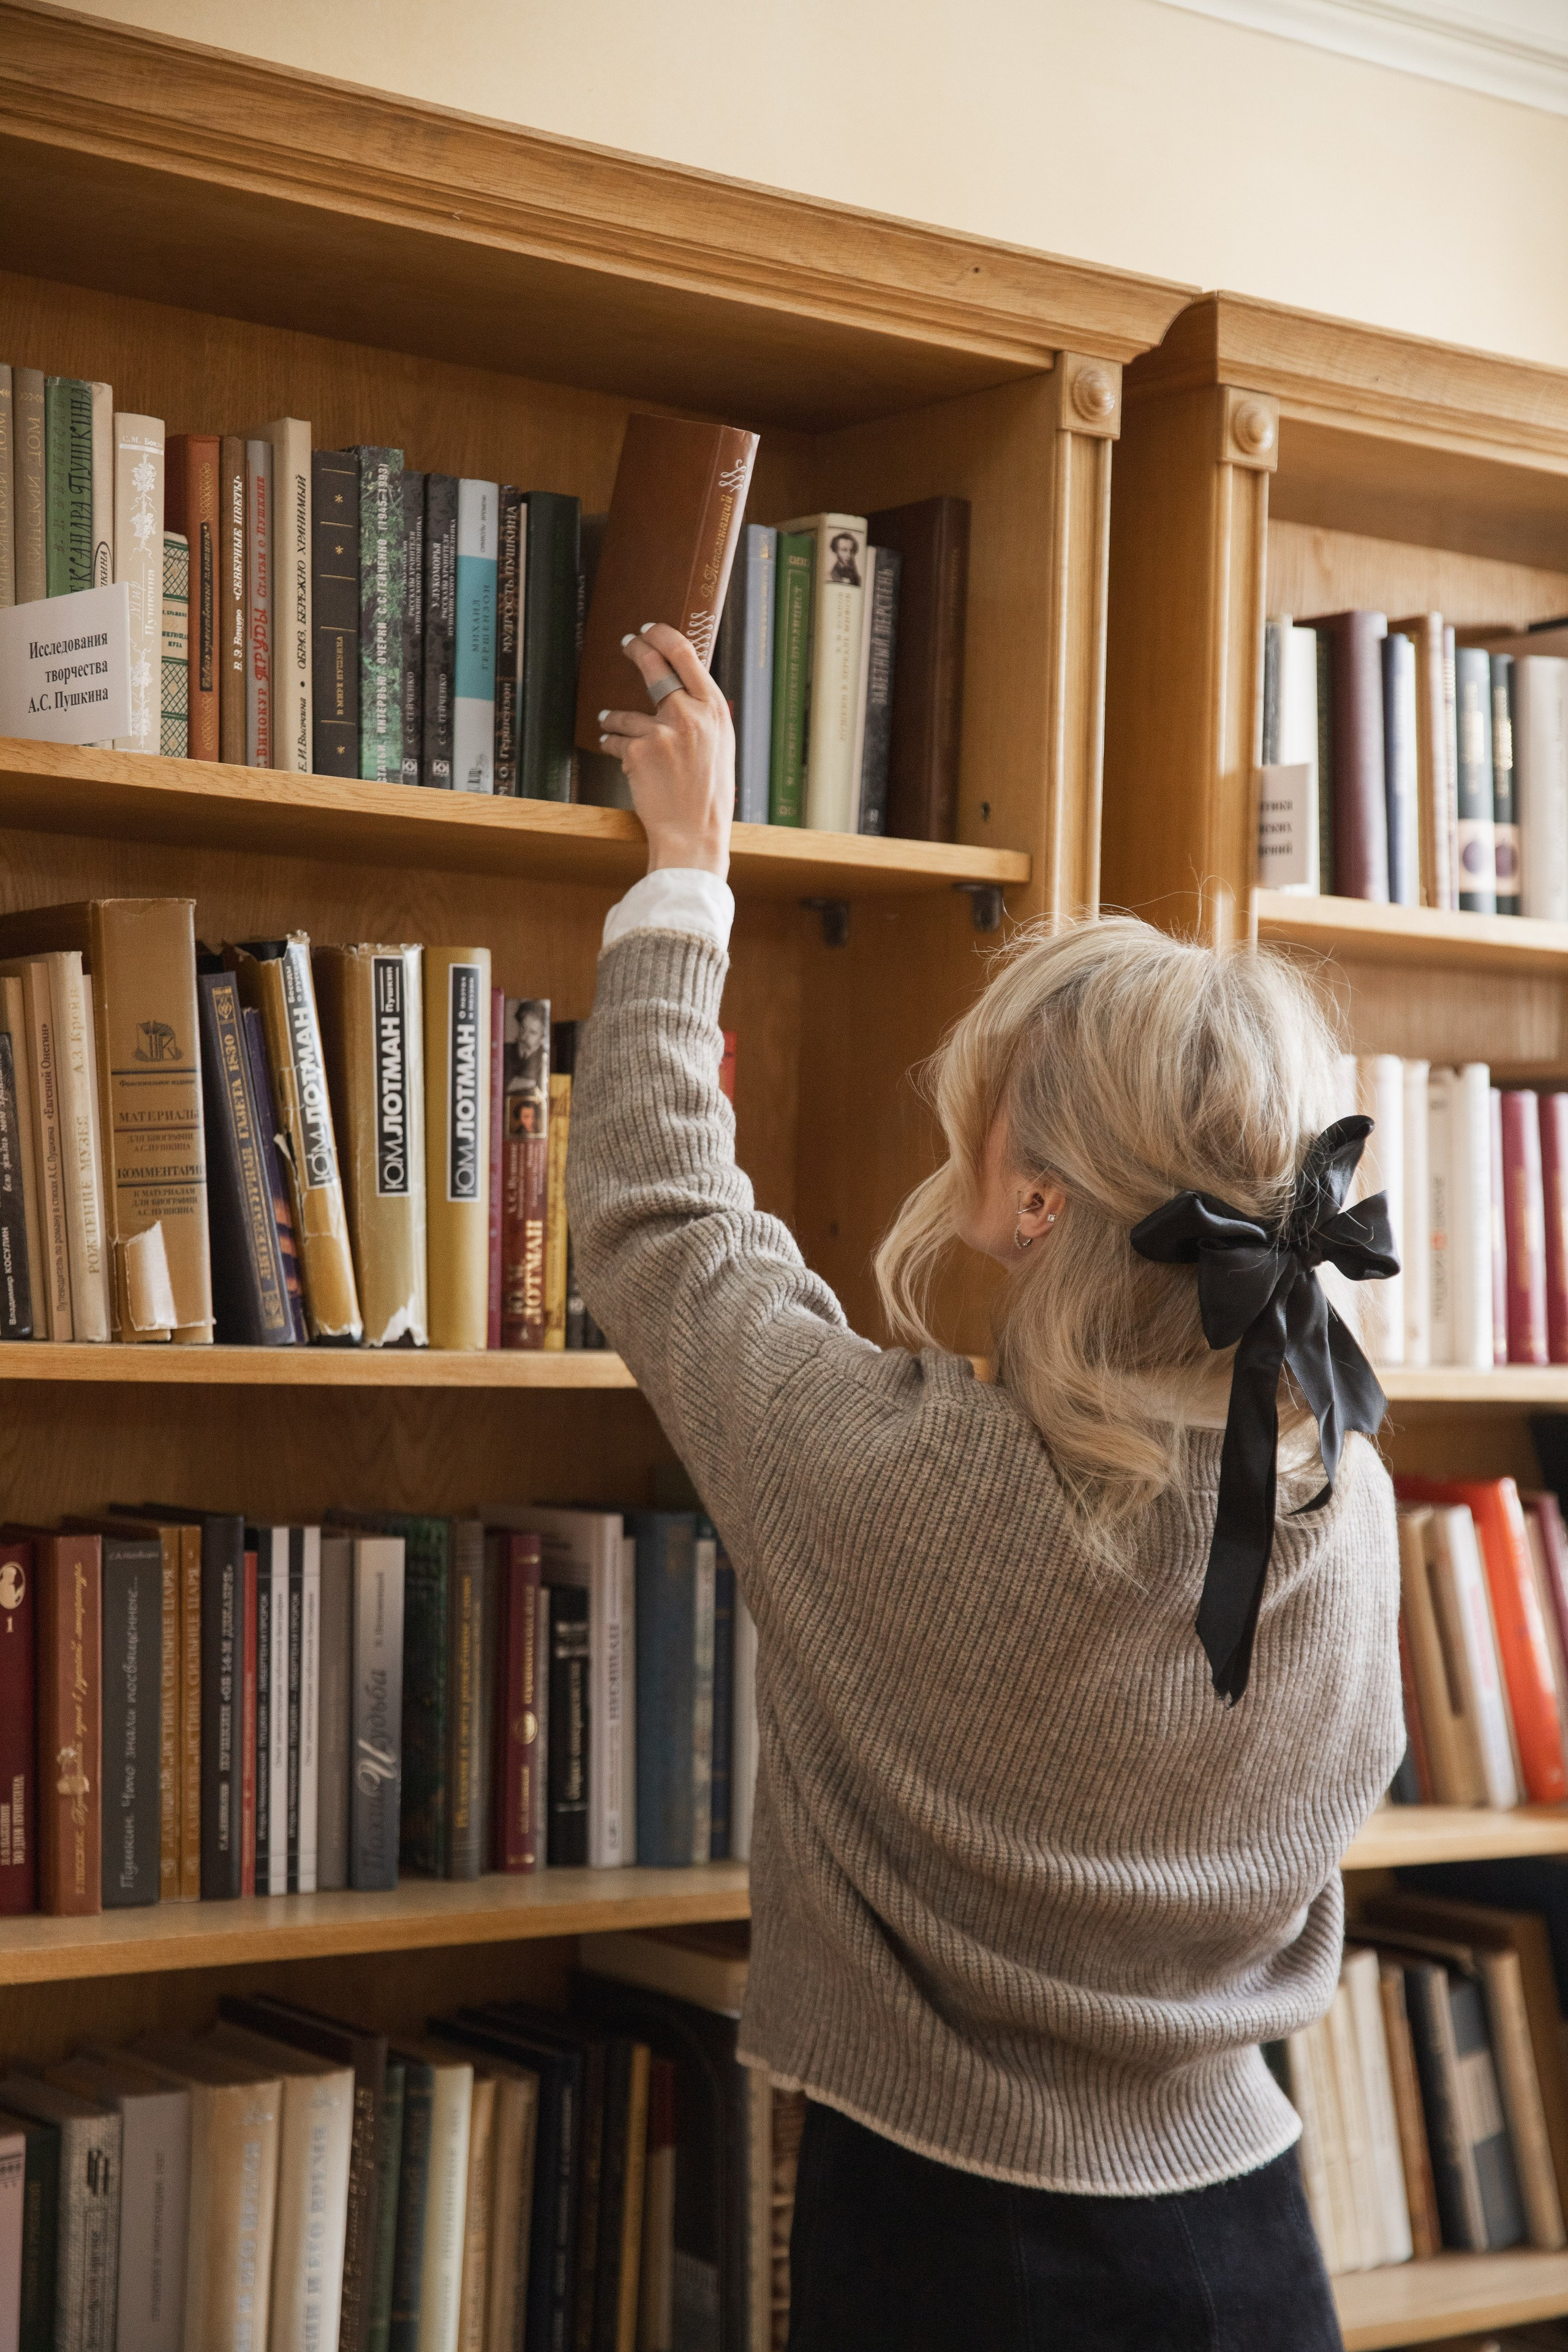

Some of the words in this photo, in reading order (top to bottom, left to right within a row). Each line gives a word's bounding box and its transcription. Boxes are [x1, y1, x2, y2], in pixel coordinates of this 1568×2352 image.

[68, 386, 92, 495] ПУШКИНА
[295, 474, 306, 556] ХРАНИМЫЙ
[504, 506, 517, 575] ПУШКИНА
[69, 502, 92, 593] ЕКСАНДРА
[432, 543, 441, 600] ЛУКОМОРЬЯ
[145, 569, 156, 635] Пушкина
[297, 560, 306, 625] БЕРЕЖНО
[502, 579, 514, 654] МУДРОСТЬ
[872, 568, 894, 636] ПЕРСТЕНЬ
[29, 633, 108, 660] Исследования
[233, 609, 244, 647] Вацуро
[376, 622, 387, 665] ОЧЕРКИ
[28, 694, 52, 714] А.С.
[55, 688, 109, 712] Пушкина
[45, 660, 108, 685] творчества
[869, 638, 890, 706] ЗАВЕТНЫЙ
[499, 682, 512, 758] Гершензон
[285, 965, 295, 1003] Беседы
[385, 966, 396, 1012] Пушкин
[40, 1023, 51, 1069] Онегин»
[224, 1035, 240, 1072] 1830
[293, 1006, 325, 1129] ЛОТМАН
[381, 1017, 404, 1137] ЛОТМАН
[41, 1071, 54, 1120] «Евгений
[232, 1079, 252, 1140] ГАЗЕТА
[455, 1023, 476, 1142] ЛОТМАН
[76, 1115, 93, 1171] МУЗЕЯ
[81, 1182, 99, 1274] РОЖДЕНИЕ
[241, 1147, 271, 1281] ЛИТЕРАТУРНАЯ
[1, 1227, 13, 1274] КОСУЛИН
[524, 1219, 543, 1325] ЛОТМАН
[6, 1276, 17, 1325] Владимир
[125, 1709, 137, 1758] знали
[219, 1705, 231, 1771] ПУШКИН
[13, 1774, 24, 1826] ПУШКИНА
